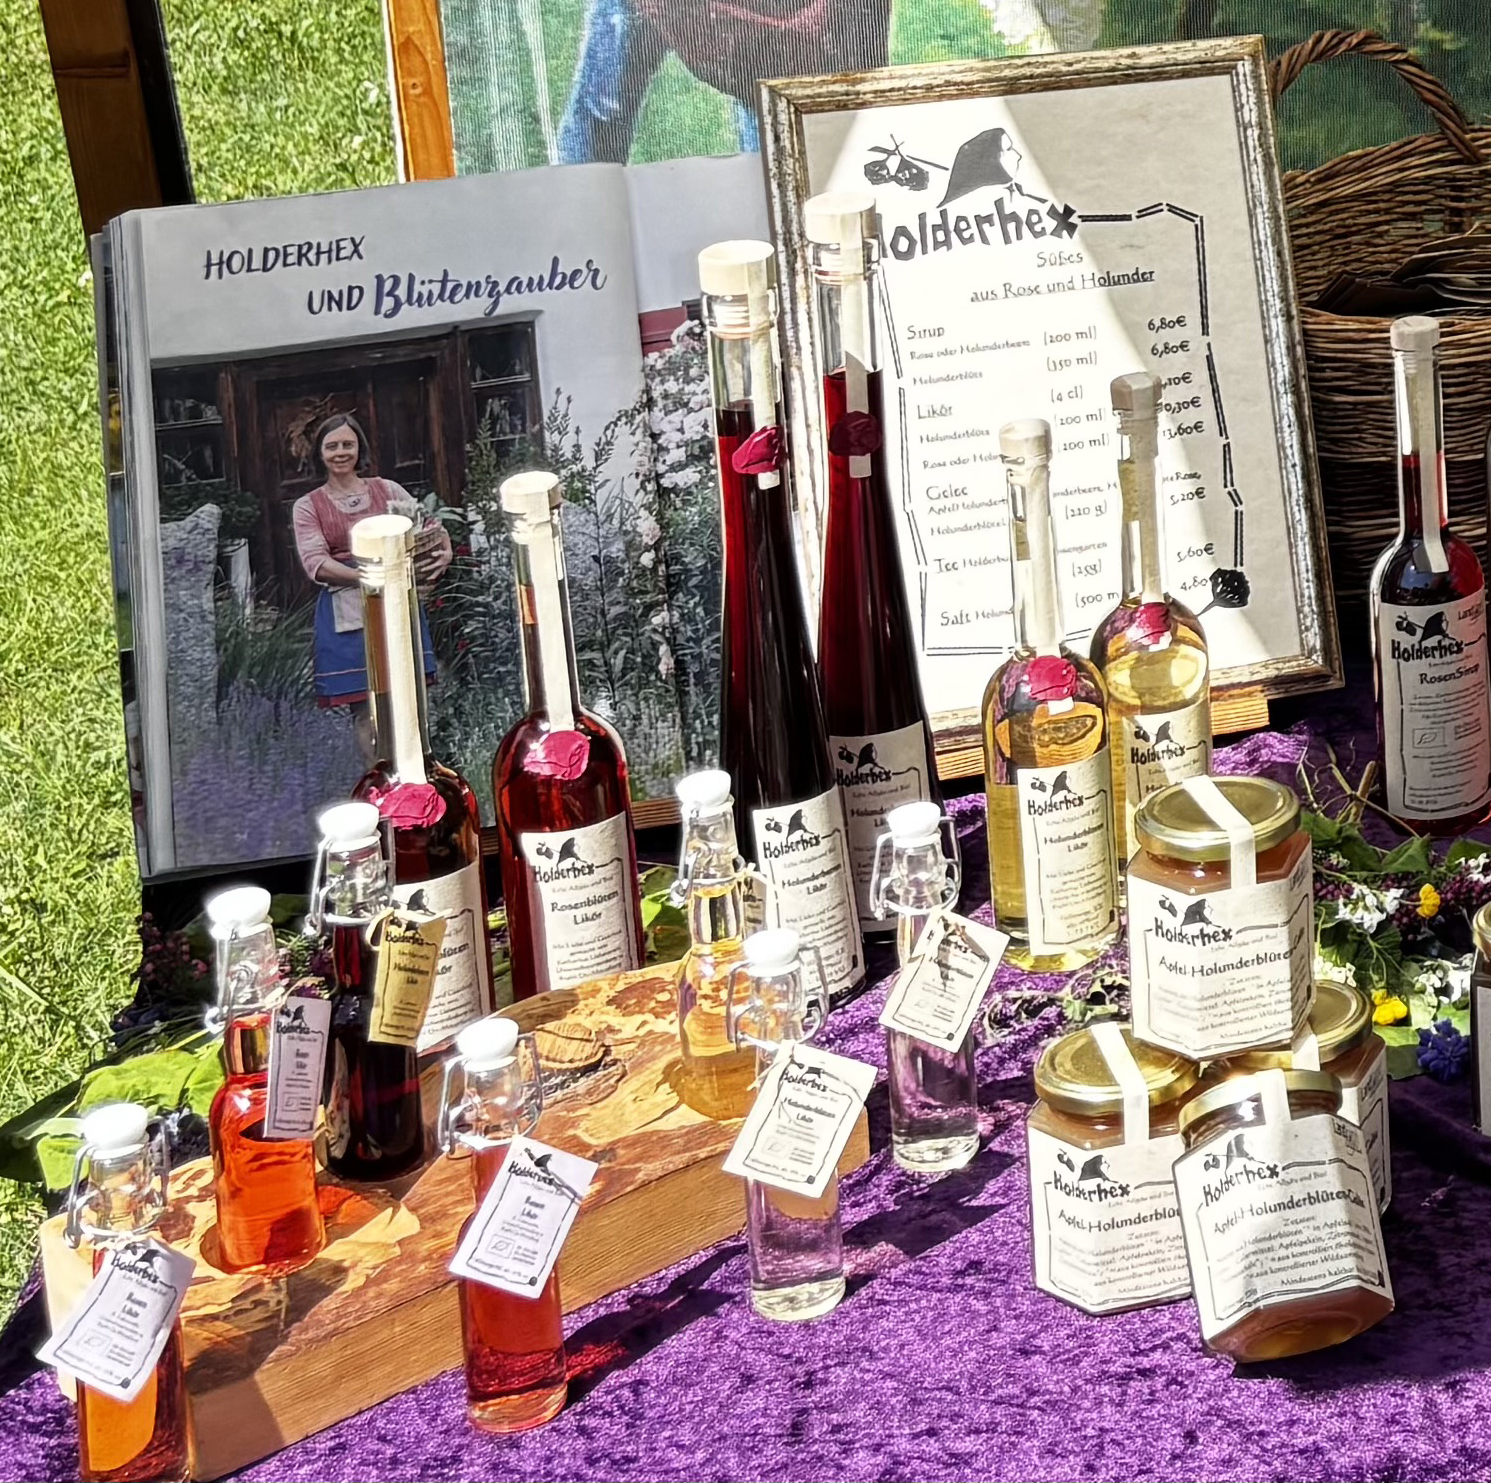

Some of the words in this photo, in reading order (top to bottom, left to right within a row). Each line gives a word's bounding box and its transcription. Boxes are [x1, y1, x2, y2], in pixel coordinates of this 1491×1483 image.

[204, 236, 366, 281] HOLDERHEX
[308, 285, 365, 315] UND
[374, 256, 607, 318] Blütenzauber
[970, 289, 998, 302] aus
[1003, 281, 1040, 299] Rose
[1048, 277, 1074, 293] und
[1083, 269, 1155, 290] Holunder
[1148, 315, 1187, 332] 6,80€
[1151, 340, 1191, 358] 6,80€
[1391, 638, 1464, 662] Holderhex
[1028, 794, 1084, 816] Holderhex
[763, 833, 821, 860] Holderhex
[534, 862, 595, 884] Holderhex
[1155, 917, 1233, 947] Holderhex
[1054, 1171, 1130, 1202] Holderhex
[1203, 1162, 1279, 1206] Holderhex
